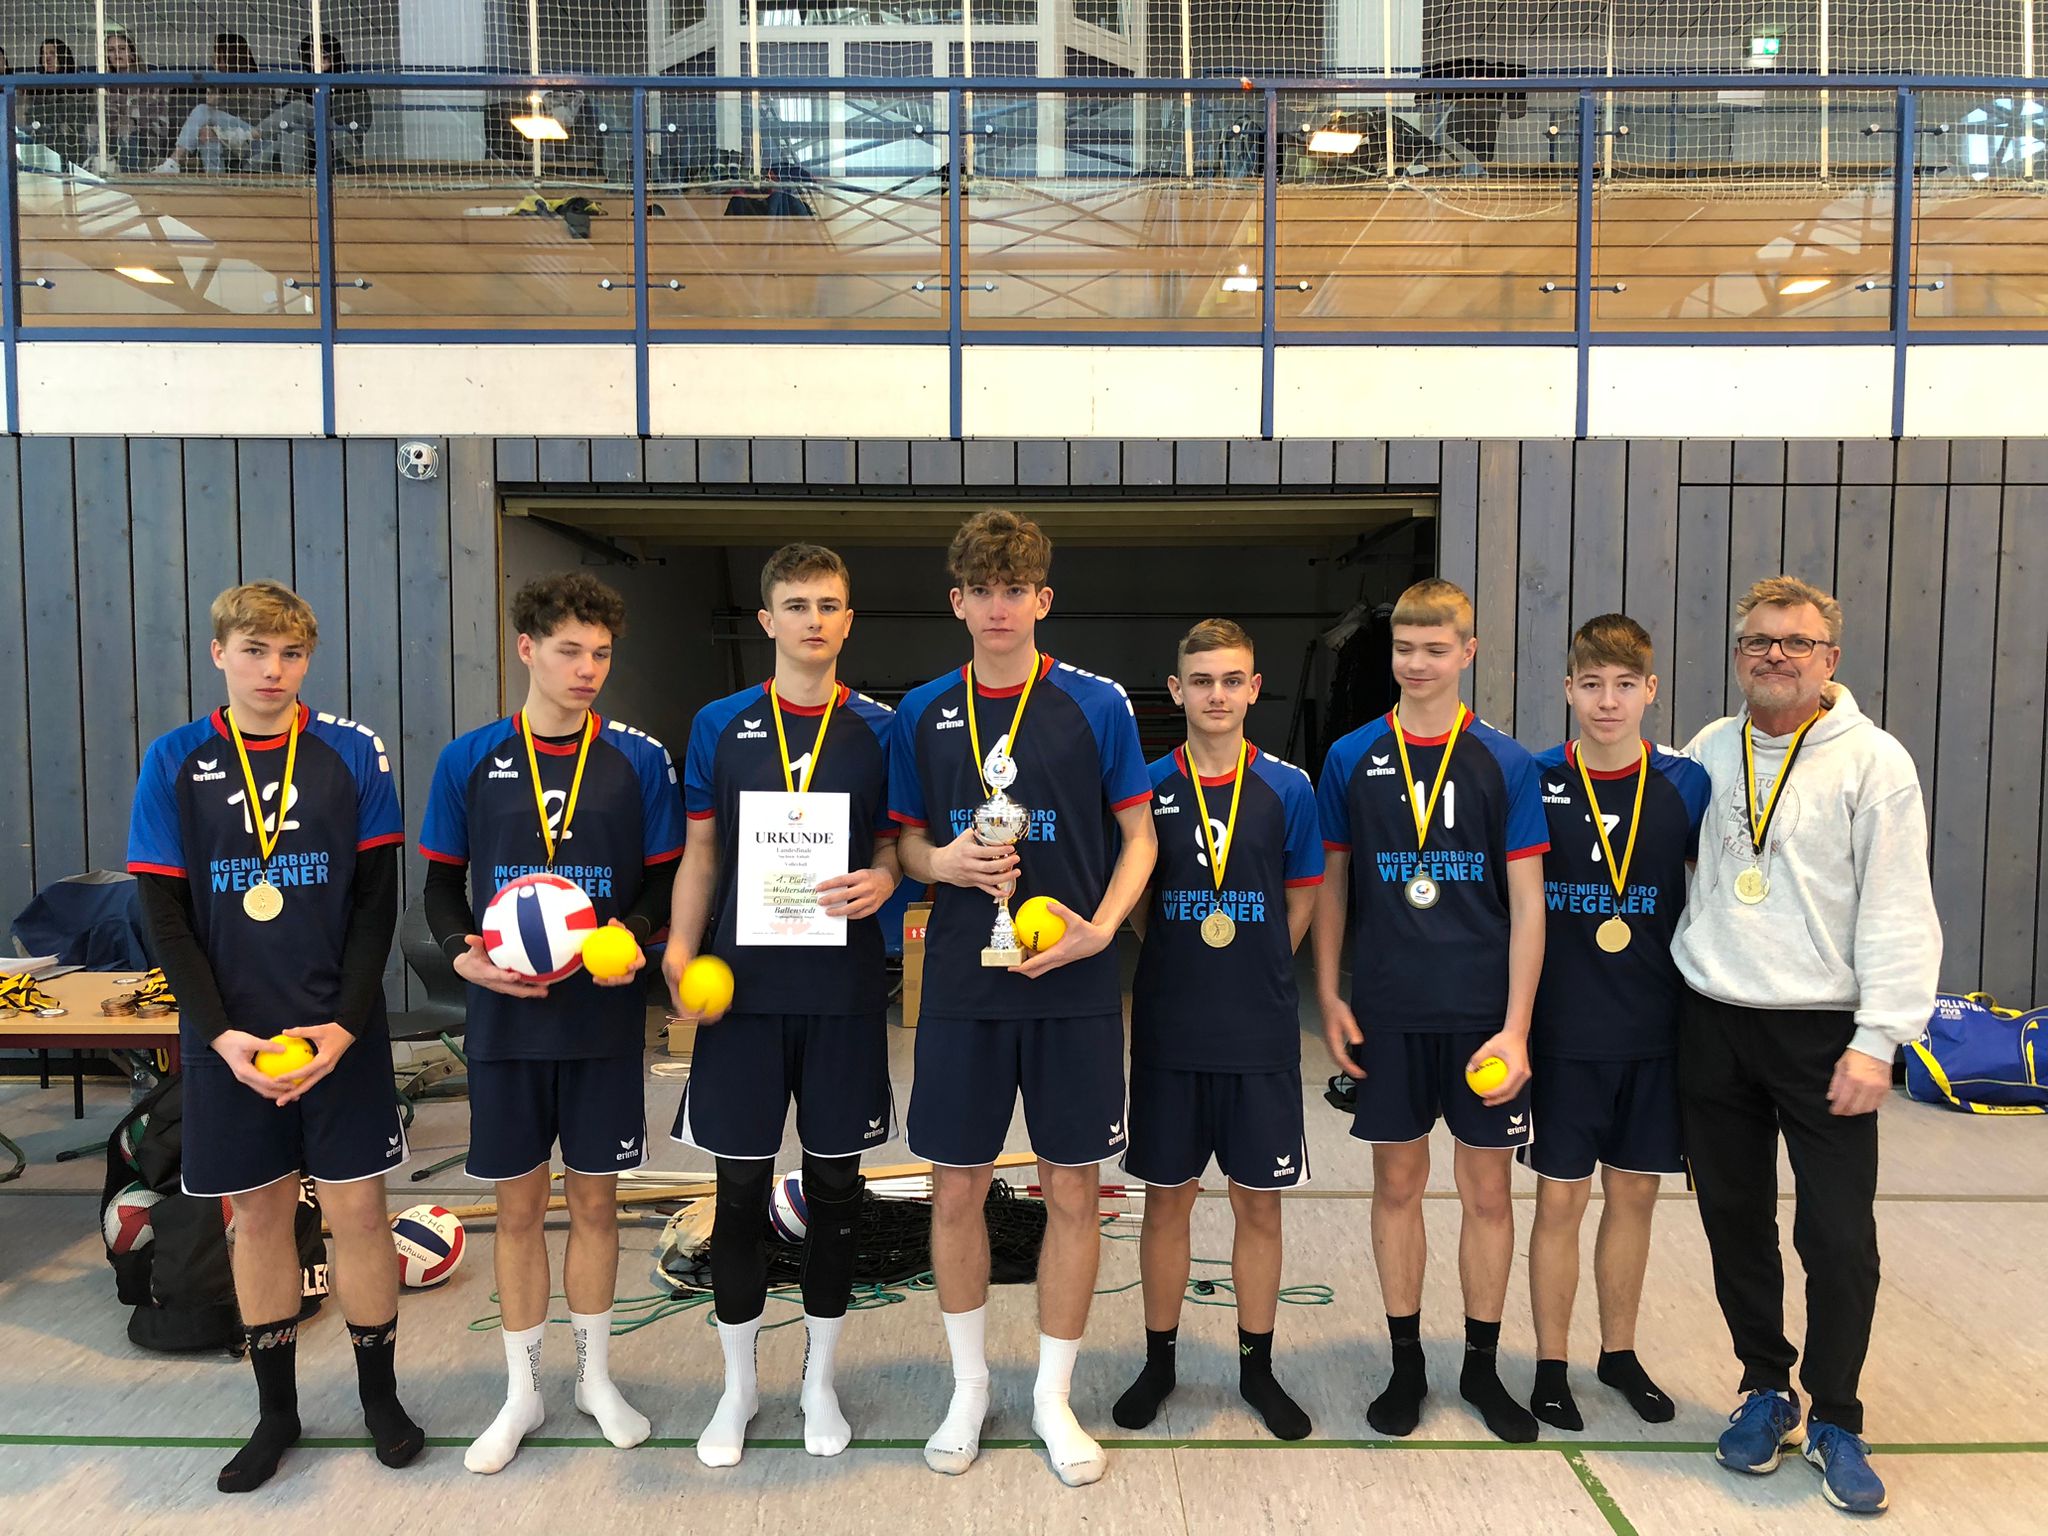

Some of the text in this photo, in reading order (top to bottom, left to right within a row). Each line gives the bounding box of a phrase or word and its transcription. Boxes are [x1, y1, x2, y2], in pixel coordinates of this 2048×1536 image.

[936, 718, 964, 730] erima
[737, 730, 767, 739] erima
[192, 769, 226, 782] erima
[488, 769, 519, 779] erima
[1366, 767, 1396, 777] erima
[227, 781, 300, 833] 12
[1154, 805, 1180, 816] erima
[537, 789, 573, 839] 2
[755, 831, 834, 844] URKUNDE
[1194, 818, 1228, 867] 9
[1585, 813, 1620, 862] 7
[1376, 851, 1485, 864] INGENEURBÜRO
[211, 864, 329, 893] WEGENER
[494, 865, 612, 879] INGENIURBÜRO
[1544, 881, 1658, 898] INGENIEUÜRO
[616, 1149, 639, 1161] erima
[1273, 1166, 1295, 1178] erima
